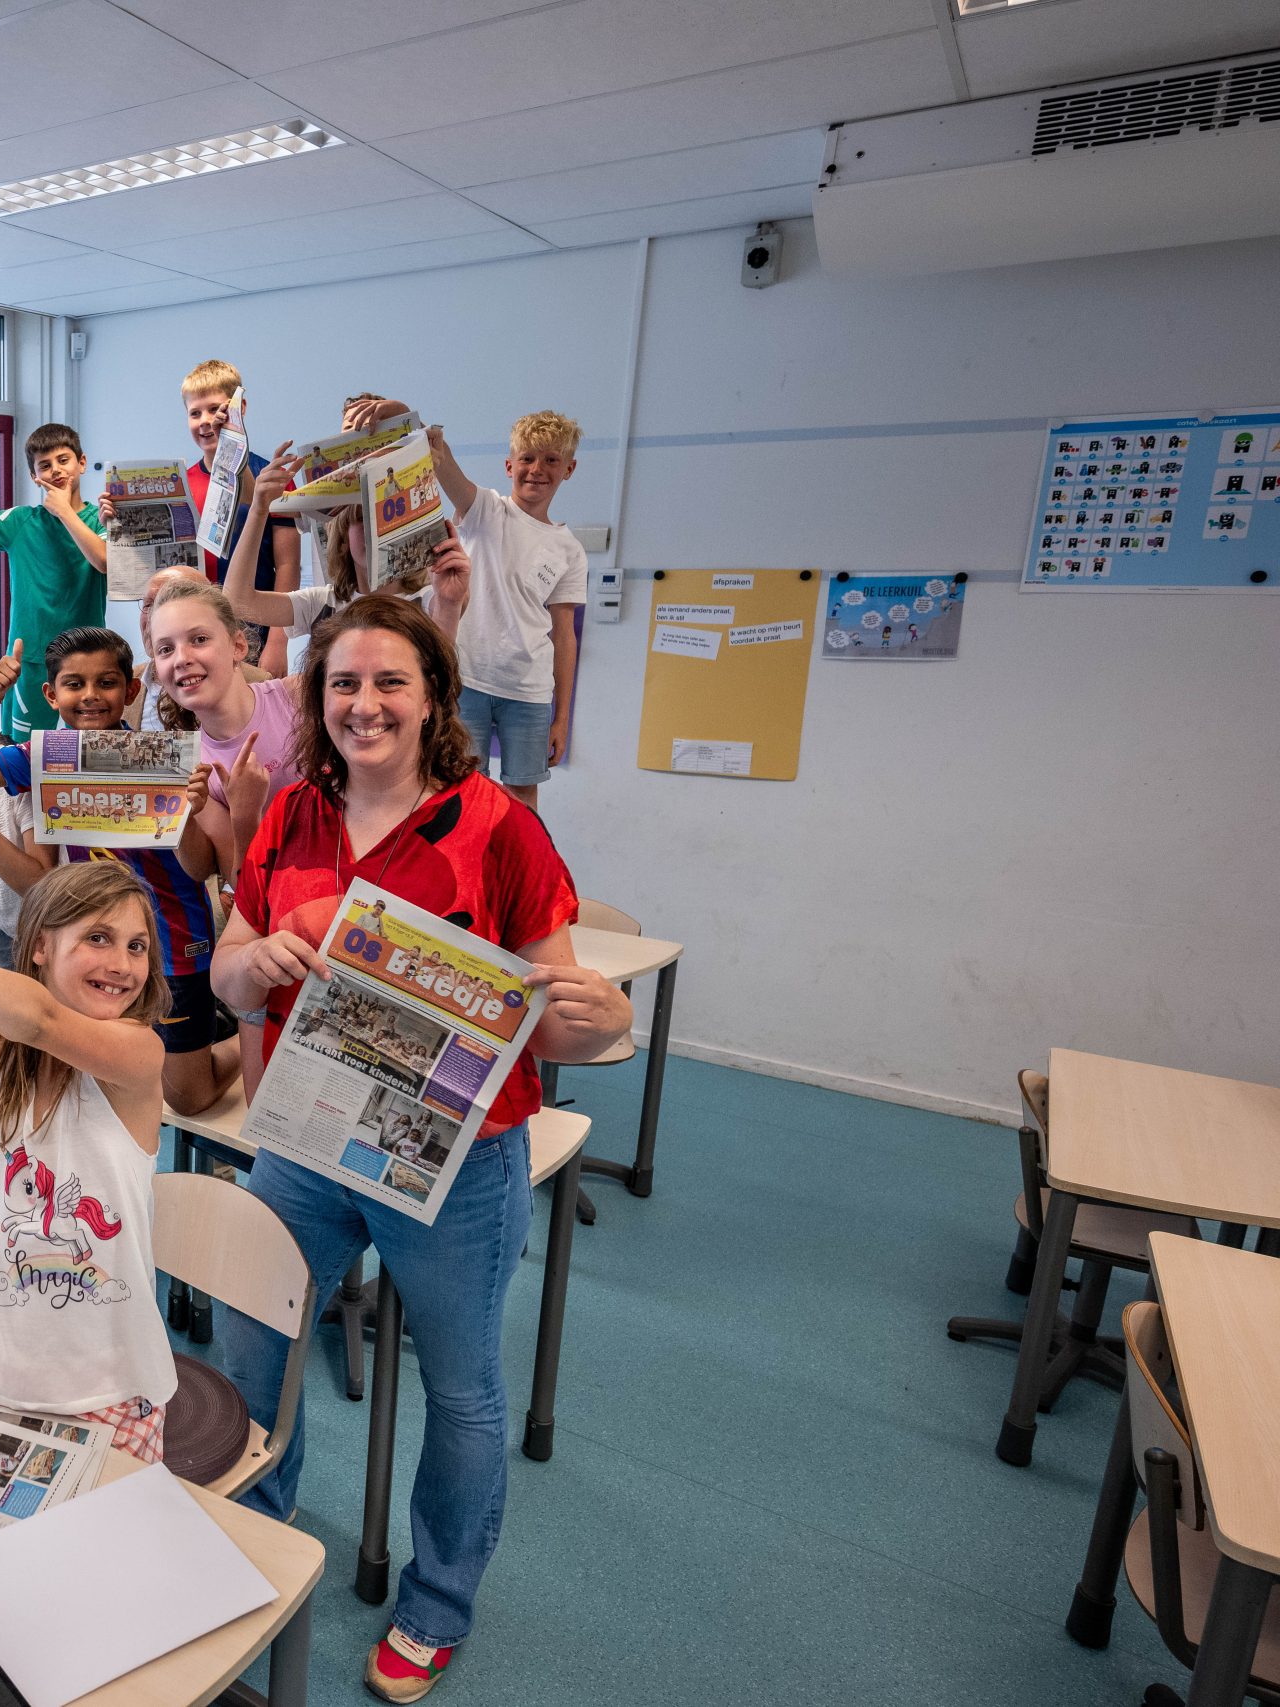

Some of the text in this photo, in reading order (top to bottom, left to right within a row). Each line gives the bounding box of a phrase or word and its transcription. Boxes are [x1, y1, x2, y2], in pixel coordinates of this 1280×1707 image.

[383, 497, 405, 522] Os
[863, 586, 923, 596] DE LEERKUIL
[344, 928, 382, 962] Os
[344, 1040, 378, 1063] Hoera!
[317, 1042, 342, 1060] krant
[345, 1054, 368, 1071] voor
[370, 1064, 415, 1095] kinderen
